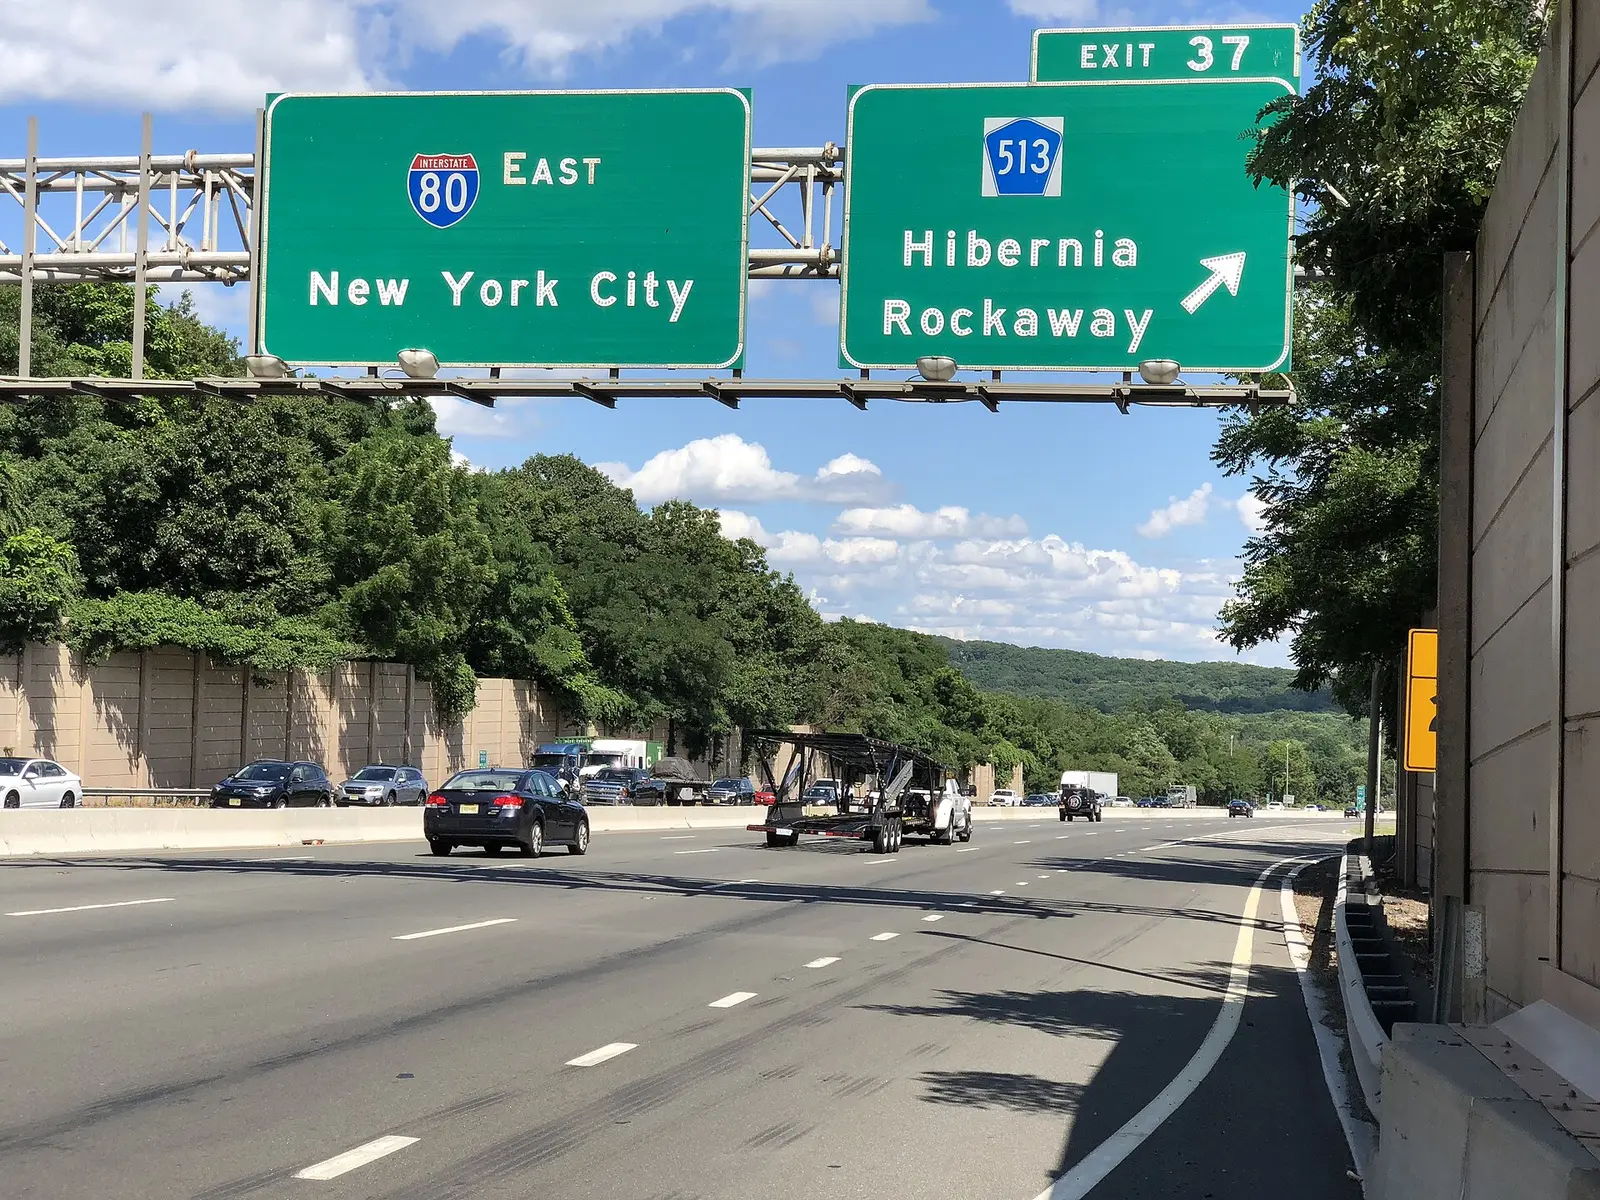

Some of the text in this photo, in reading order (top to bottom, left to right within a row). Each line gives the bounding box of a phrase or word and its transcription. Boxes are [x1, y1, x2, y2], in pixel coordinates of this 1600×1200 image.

[1080, 35, 1250, 72] EXIT 37
[419, 158, 469, 169] INTERSTATE
[503, 151, 601, 185] EAST
[997, 138, 1051, 175] 513
[418, 172, 469, 214] 80
[903, 229, 1138, 267] Hibernia
[309, 270, 694, 323] New York City
[883, 298, 1154, 354] Rockaway
